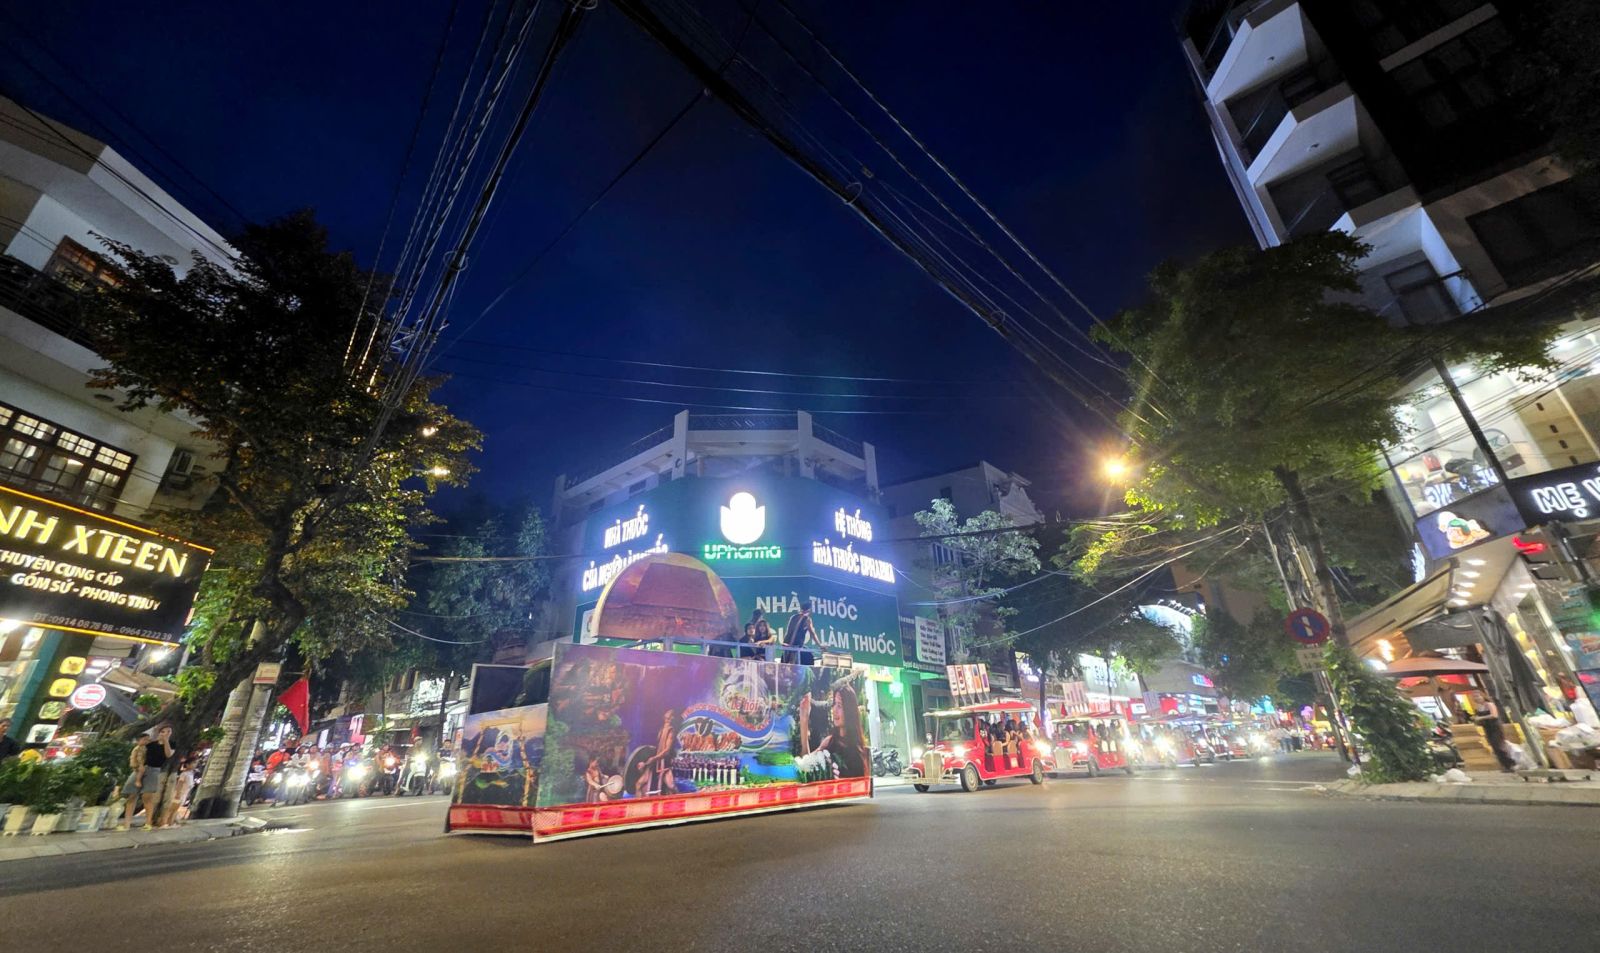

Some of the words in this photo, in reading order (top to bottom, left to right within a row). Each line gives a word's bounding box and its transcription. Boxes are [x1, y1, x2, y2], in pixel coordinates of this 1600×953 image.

[621, 504, 649, 543] THUỐC
[834, 507, 846, 538] HỆ
[0, 549, 56, 573] HUYÊN
[54, 562, 95, 581] CUNG
[96, 571, 124, 586] CẤP
[11, 571, 51, 590] GỐM
[49, 579, 75, 594] SỨ
[79, 586, 127, 606] PHONG
[755, 591, 801, 614] NHÀ
[808, 596, 858, 621] THUỐC
[820, 626, 850, 649] LÀM
[852, 632, 896, 656] THUỐC
